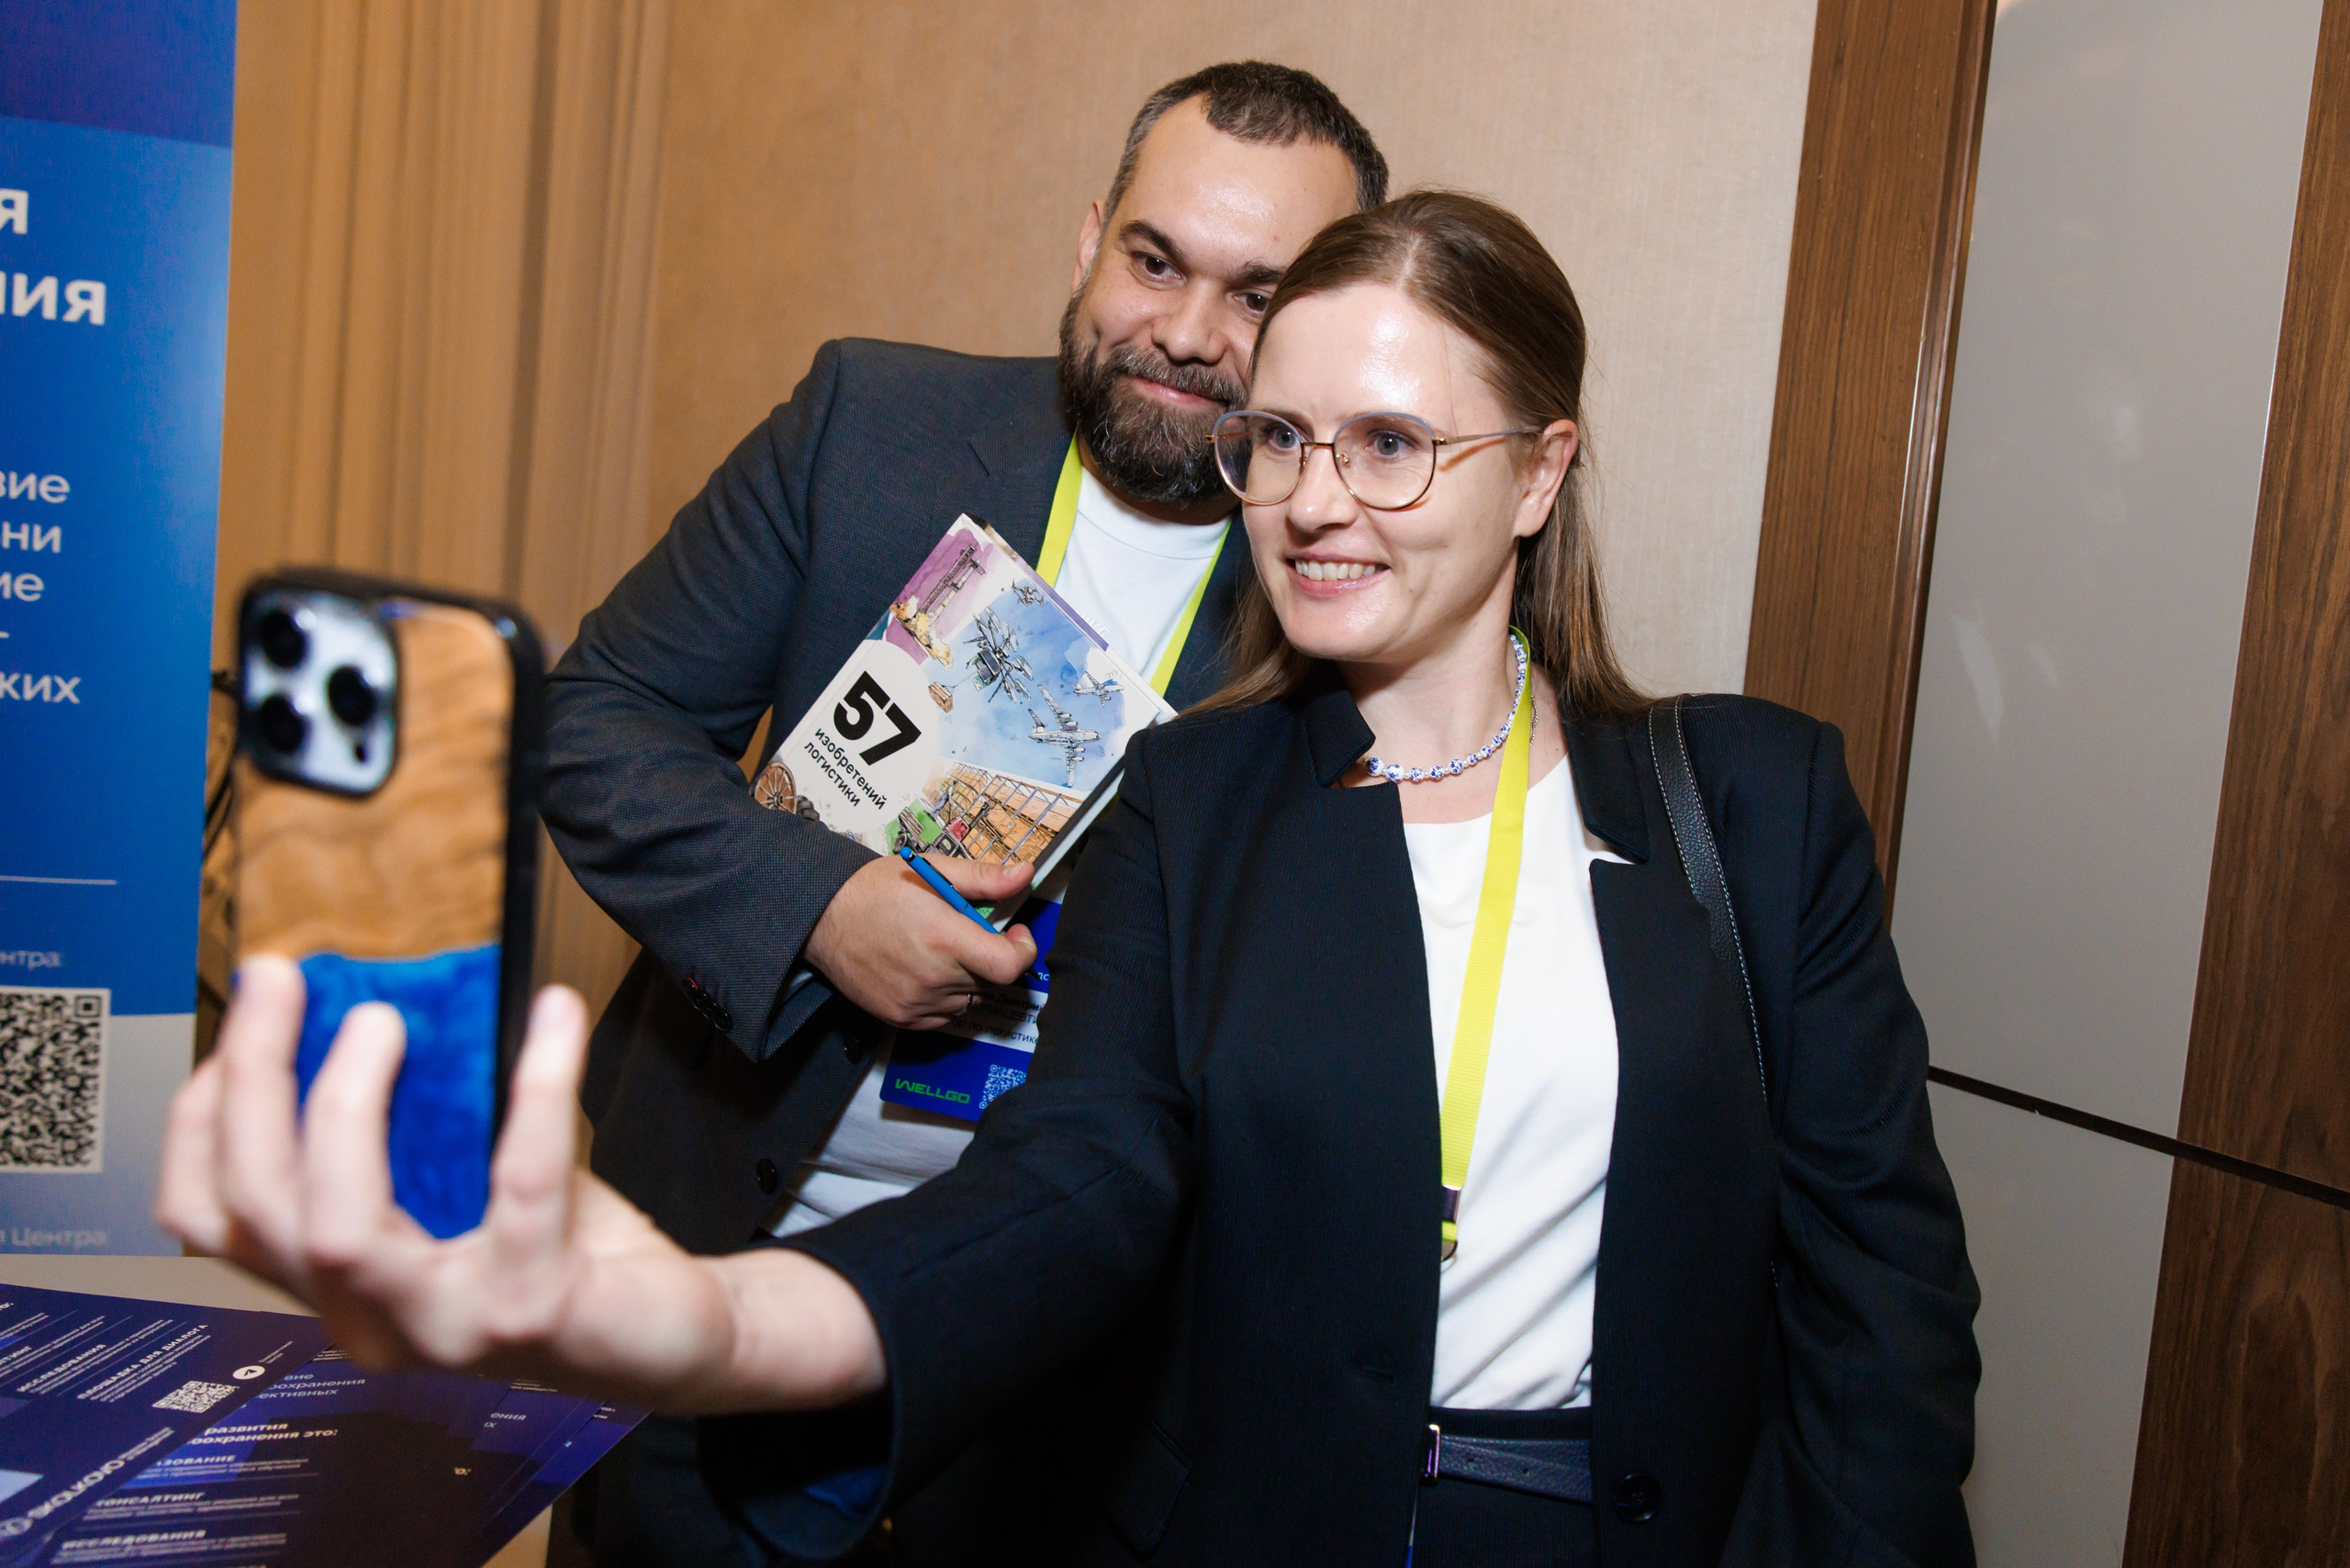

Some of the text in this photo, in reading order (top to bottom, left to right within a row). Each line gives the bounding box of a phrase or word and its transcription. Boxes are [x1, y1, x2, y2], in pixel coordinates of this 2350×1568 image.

[0, 270, 106, 326] ия
[0, 470, 70, 504] ие
[834, 670, 923, 767] 57
[804, 741, 861, 808] логистики
[814, 727, 888, 811] изобретений
[894, 1078, 971, 1104] WELLGO
[162, 1324, 208, 1351] ДИАЛОГА
[187, 1431, 300, 1446] оохранения
[204, 1423, 289, 1437] развития
